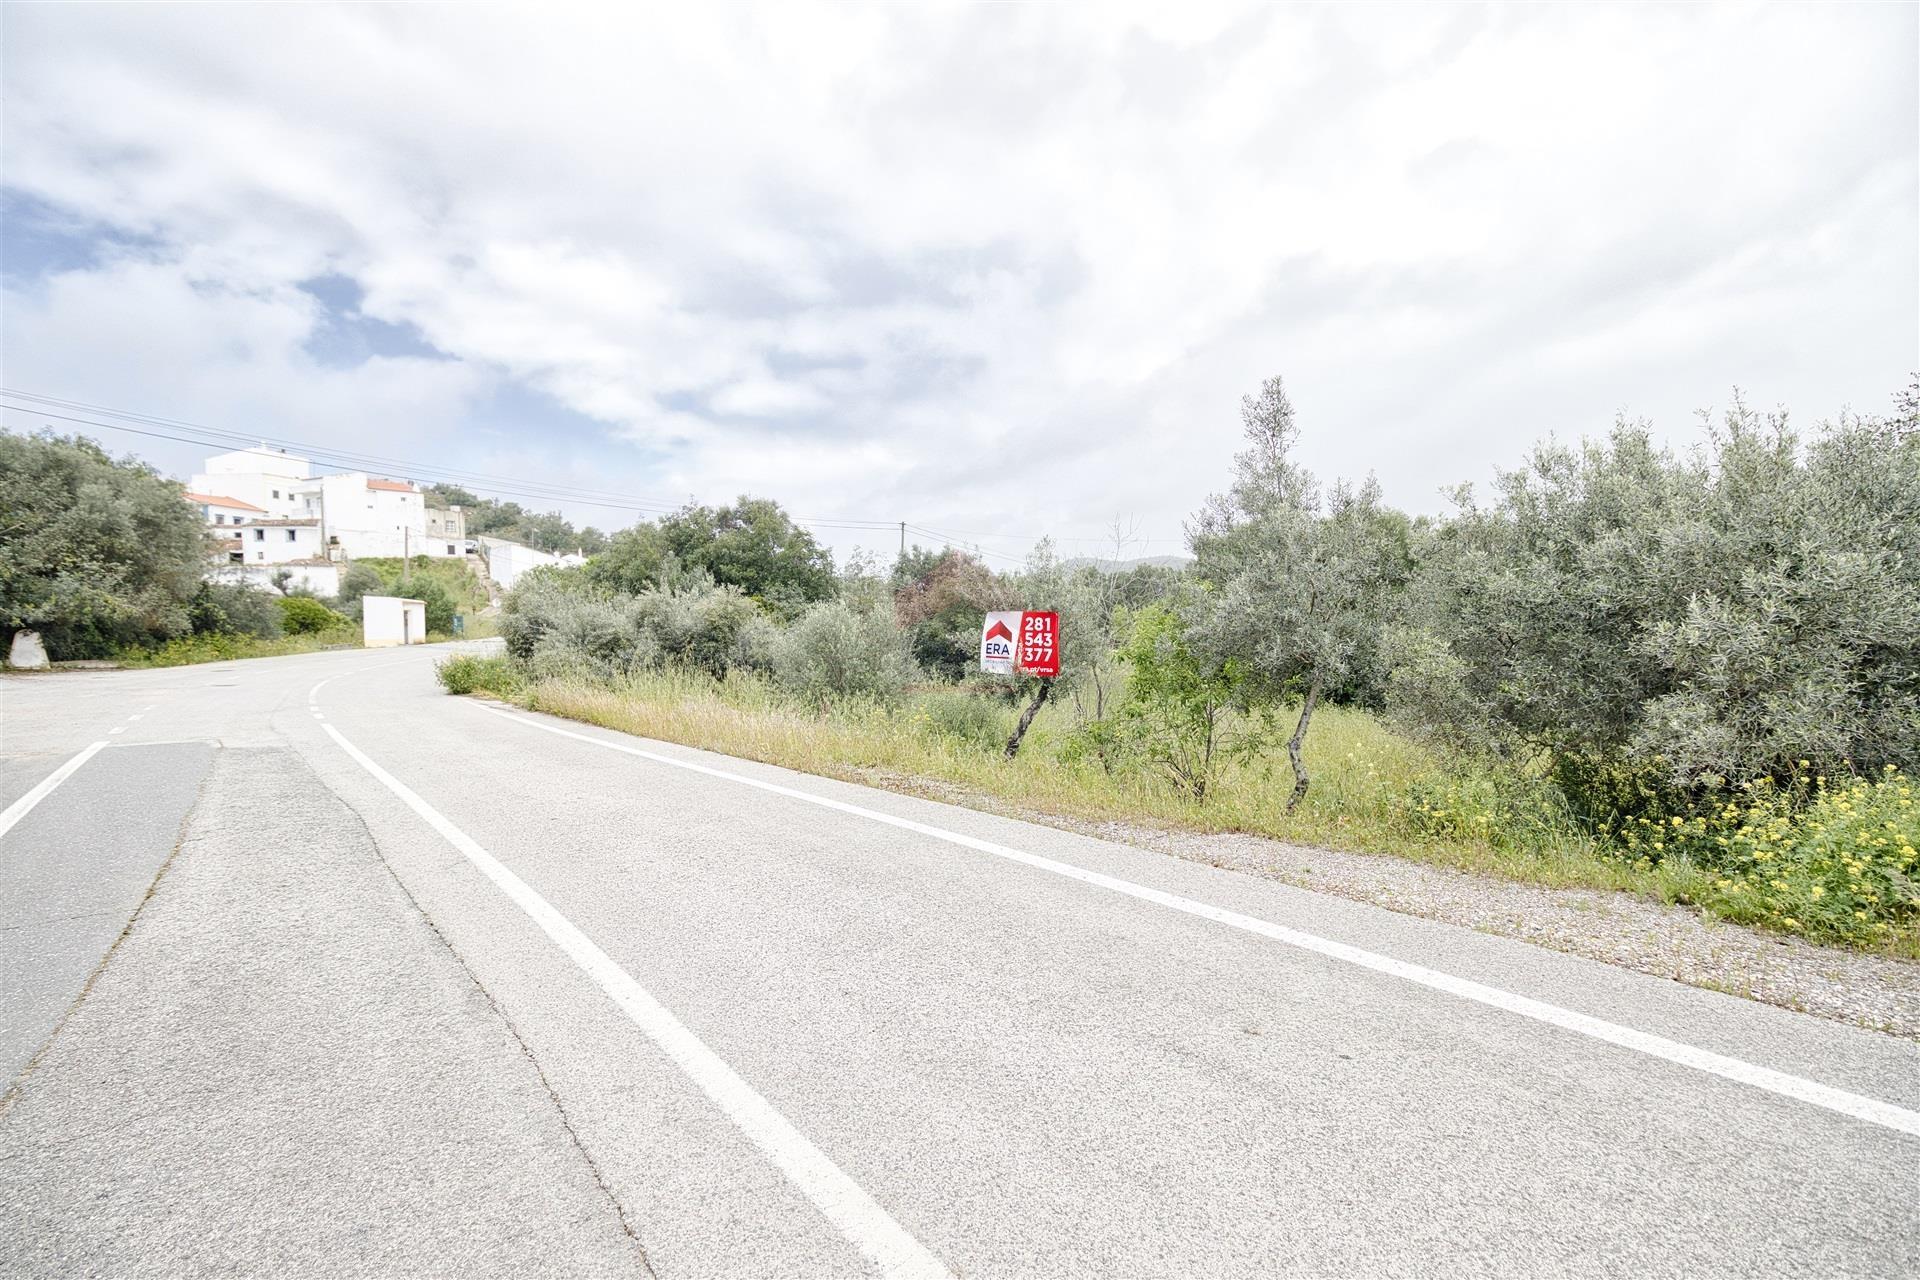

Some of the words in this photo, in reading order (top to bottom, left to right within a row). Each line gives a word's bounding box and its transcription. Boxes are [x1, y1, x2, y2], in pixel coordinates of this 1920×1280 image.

[1025, 617, 1051, 631] 281
[1025, 632, 1052, 647] 543
[986, 643, 1010, 655] ERA
[1024, 647, 1053, 662] 377
